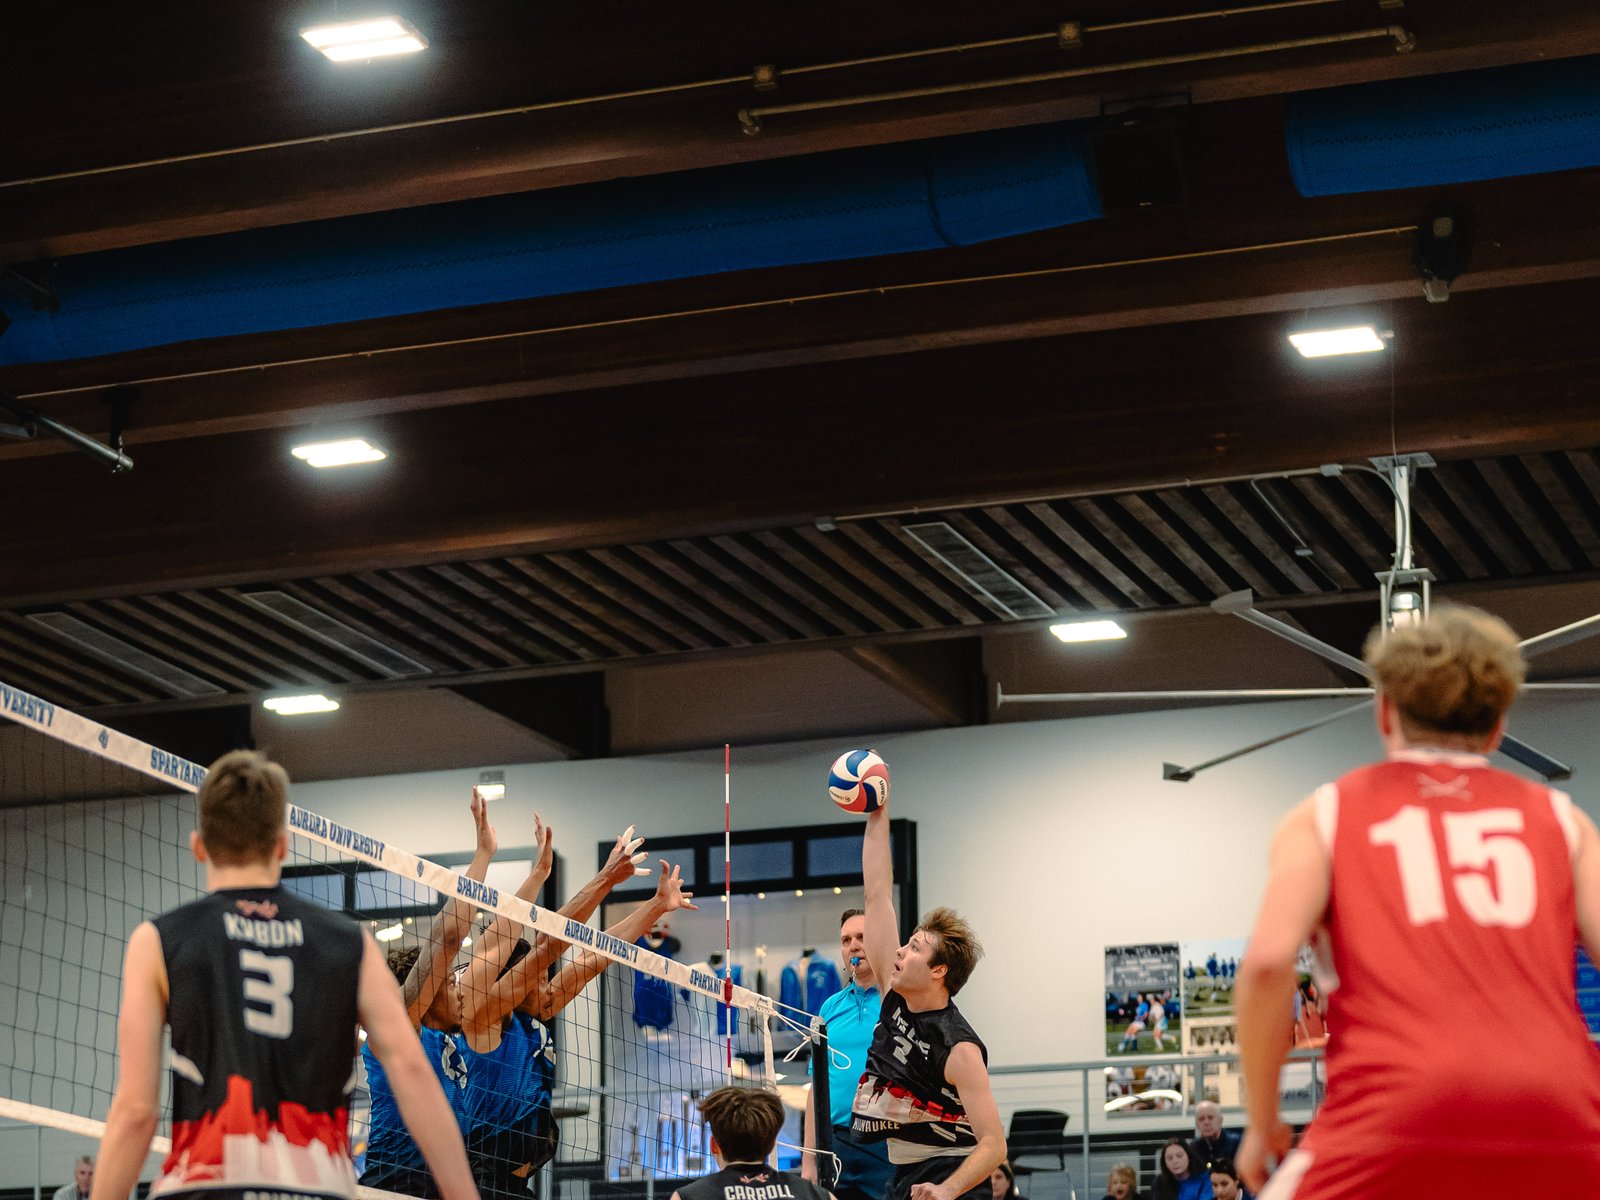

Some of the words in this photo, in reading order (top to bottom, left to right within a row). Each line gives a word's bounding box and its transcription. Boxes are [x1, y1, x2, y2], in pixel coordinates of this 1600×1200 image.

[0, 686, 55, 727] VERSITY
[290, 806, 328, 838] AURORA
[329, 822, 386, 861] UNIVERSITY
[1368, 805, 1537, 928] 15
[457, 875, 498, 908] SPARTANS
[564, 919, 594, 945] AURORA
[239, 948, 294, 1040] 3
[724, 1184, 795, 1200] CARROLL
